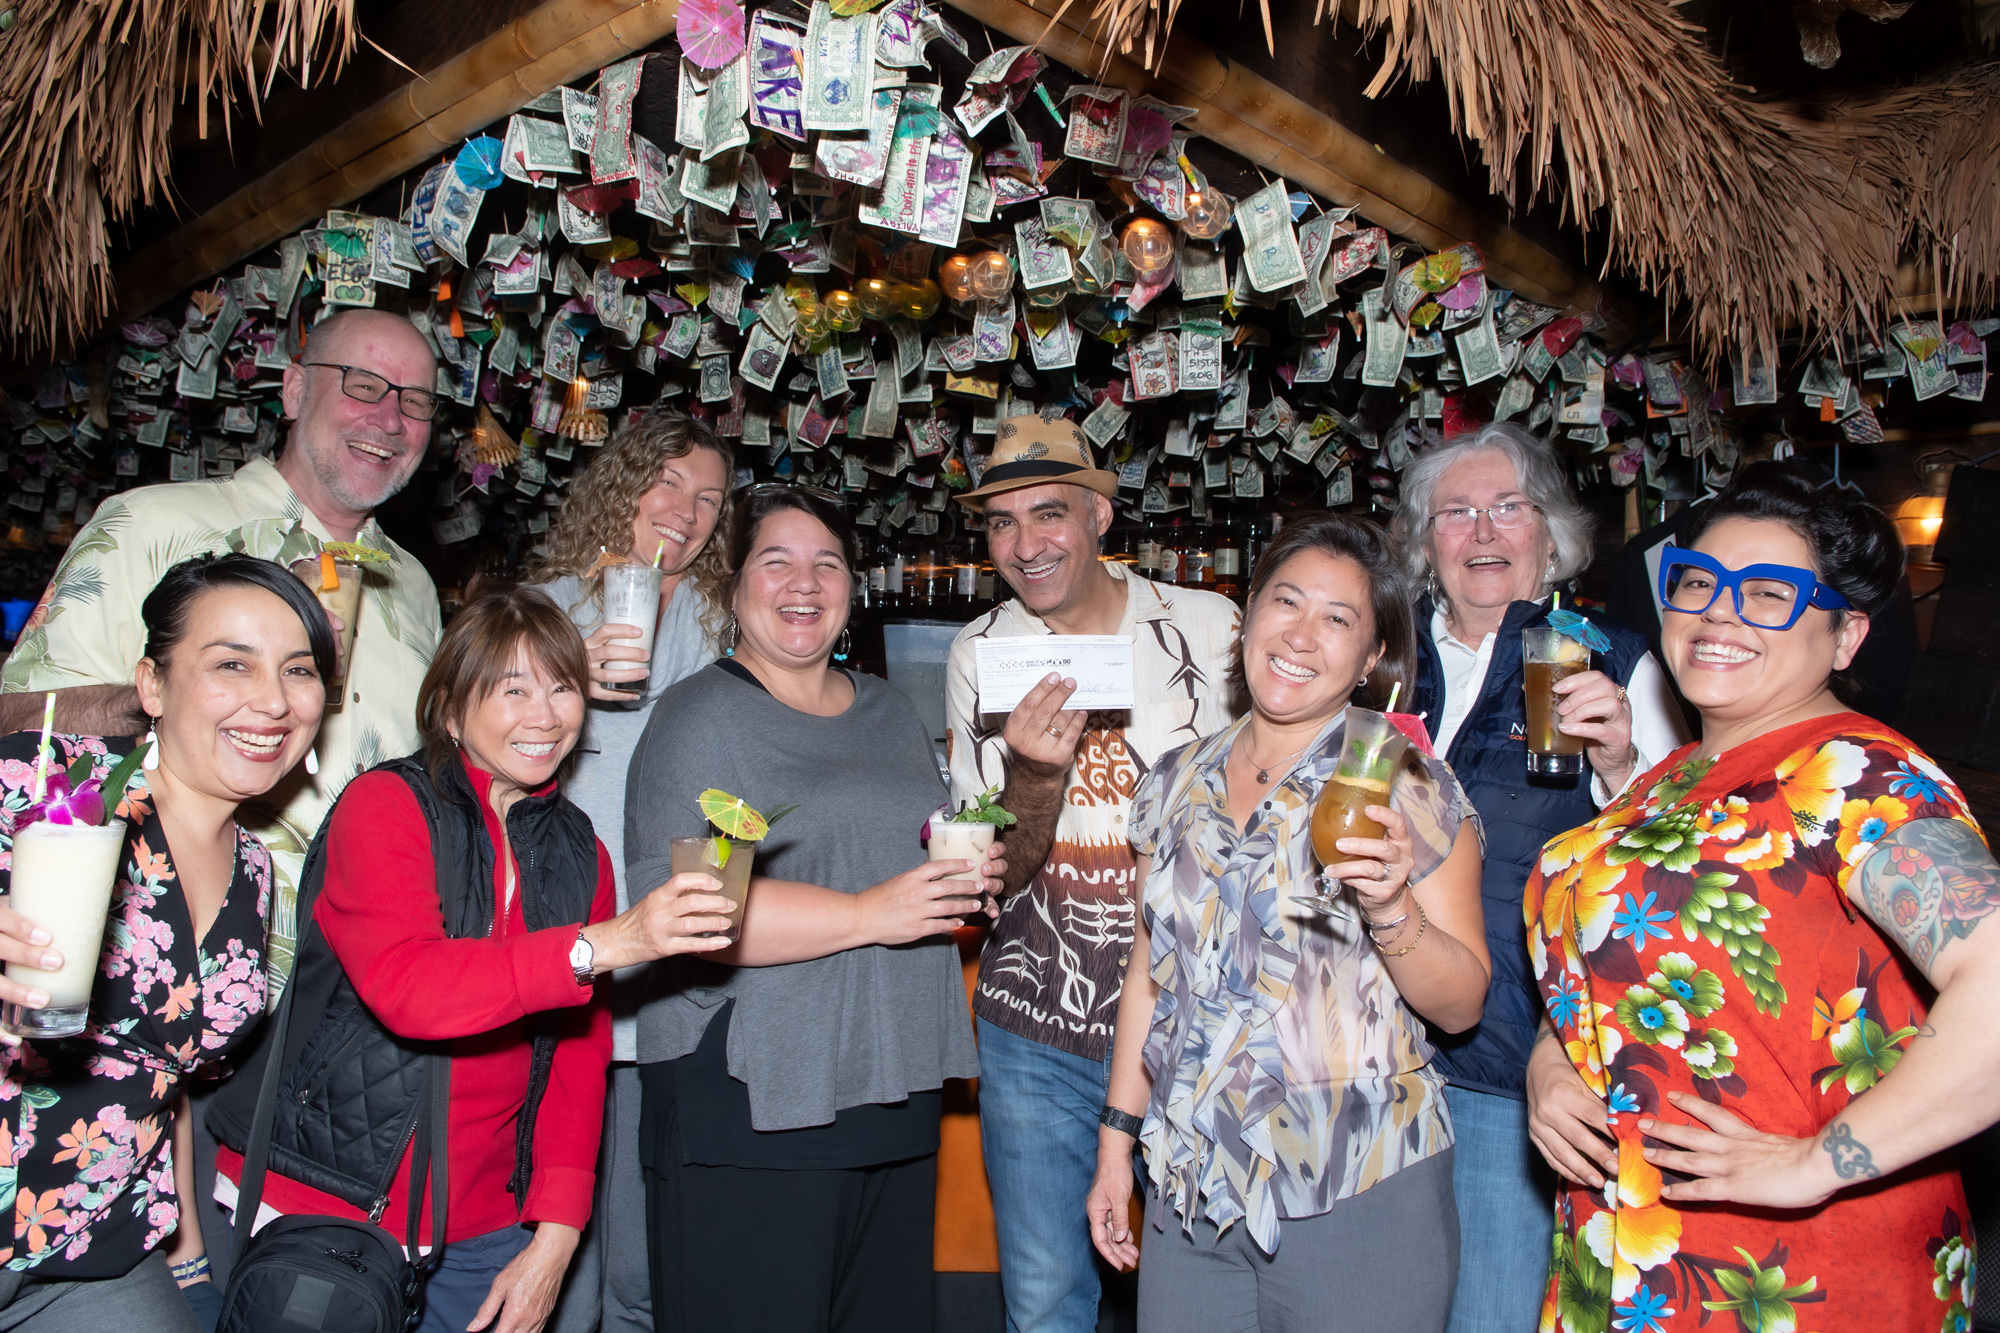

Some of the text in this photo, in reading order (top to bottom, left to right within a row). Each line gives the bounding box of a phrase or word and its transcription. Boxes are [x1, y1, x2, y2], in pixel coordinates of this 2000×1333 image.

[818, 36, 828, 57] VITA
[878, 145, 889, 171] WHEN
[884, 124, 894, 143] THE
[1183, 349, 1210, 358] THE
[1188, 359, 1220, 369] SISTAS
[1189, 371, 1213, 380] 2016
[1566, 410, 1580, 420] 5
